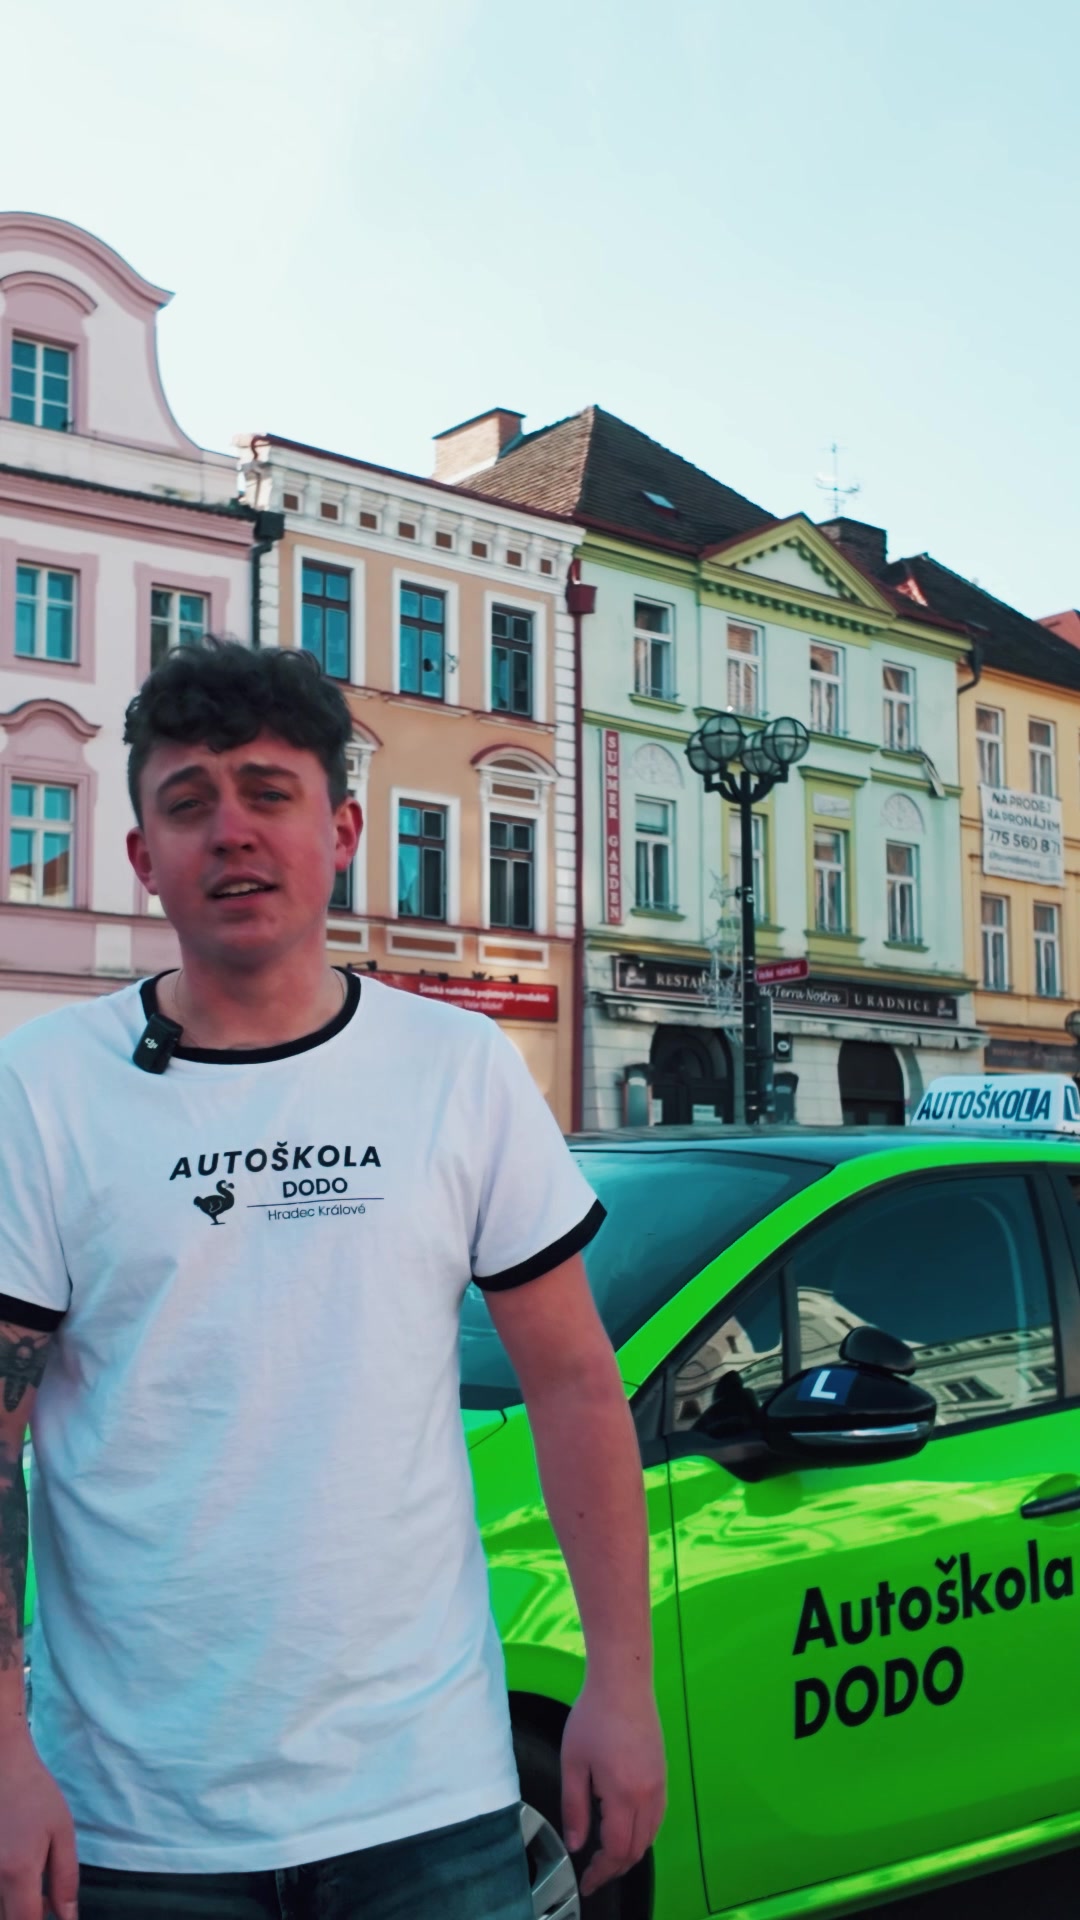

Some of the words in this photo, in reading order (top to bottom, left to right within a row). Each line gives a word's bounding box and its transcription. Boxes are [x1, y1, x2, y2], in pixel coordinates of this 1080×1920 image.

[607, 736, 618, 819] SUMMER
[992, 792, 1007, 805] NA
[1009, 796, 1051, 814] PRODEJ
[1013, 833, 1037, 850] 560
[608, 835, 620, 918] GARDEN
[854, 994, 863, 1005] U
[867, 996, 931, 1012] RADNICE
[917, 1084, 1052, 1122] AUTOŠKOLA
[169, 1141, 381, 1181] AUTOŠKOLA
[282, 1177, 348, 1198] DODO
[268, 1207, 315, 1221] Hradec
[318, 1203, 366, 1217] Králové
[810, 1370, 837, 1400] L
[792, 1539, 1073, 1656] Autoškola
[794, 1646, 964, 1740] DODO
